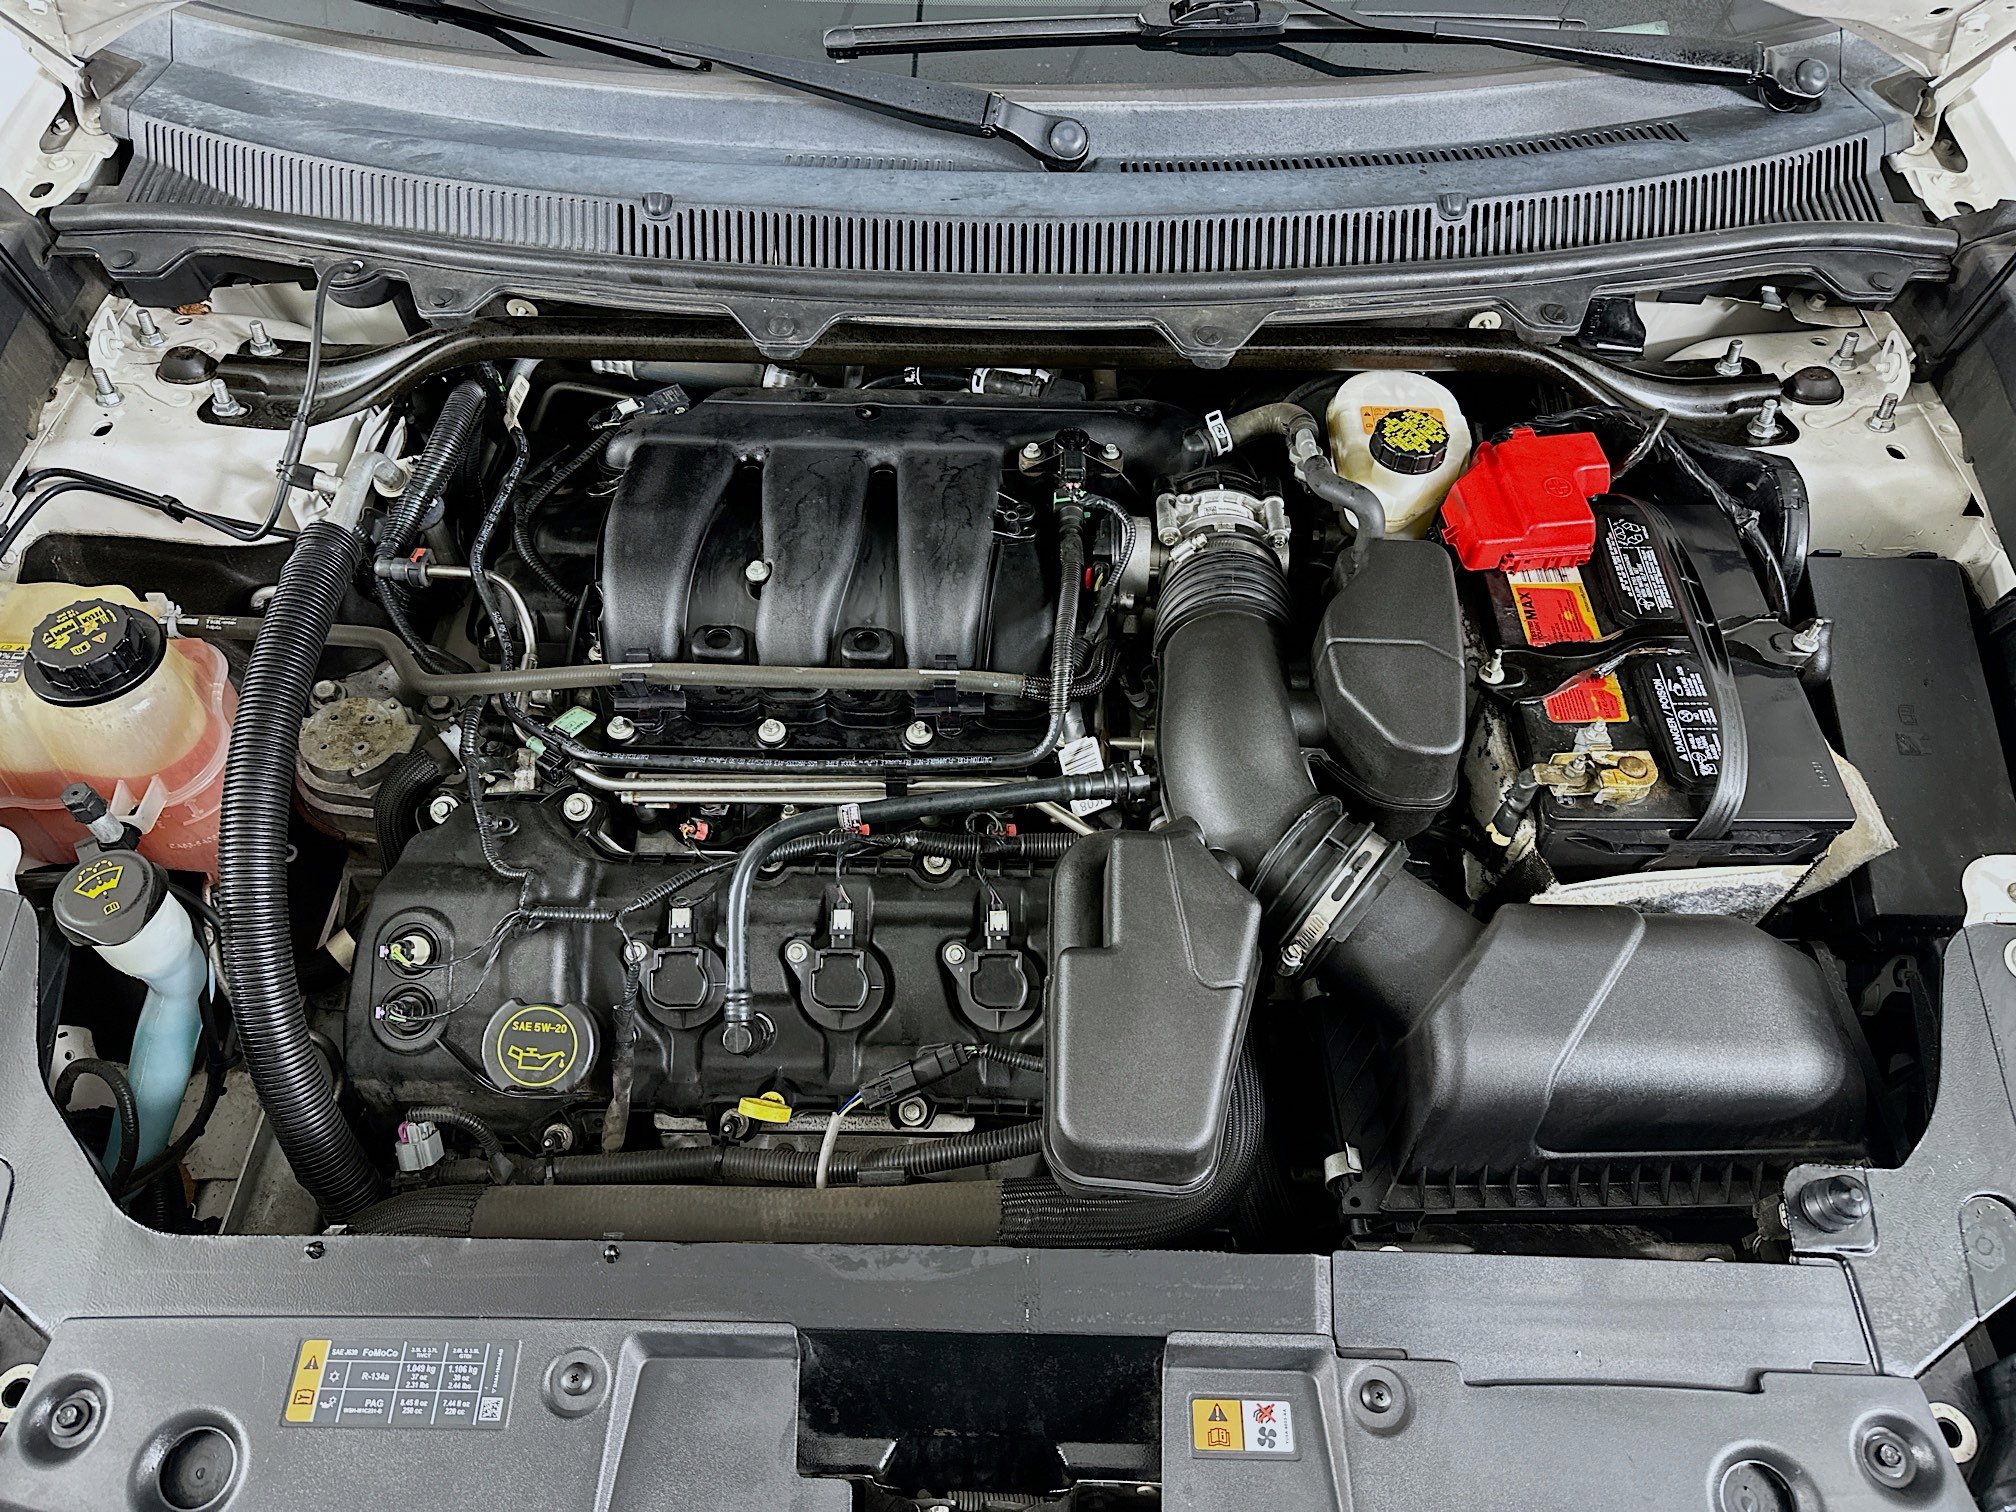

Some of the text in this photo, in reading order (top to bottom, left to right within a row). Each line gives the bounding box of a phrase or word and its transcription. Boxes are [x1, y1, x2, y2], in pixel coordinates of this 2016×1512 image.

[1518, 592, 1538, 620] MAX
[1652, 678, 1672, 710] POISON
[1665, 717, 1686, 753] DANGER
[512, 1021, 568, 1034] SAE 5W-20
[332, 1348, 344, 1356] SAE
[362, 1348, 399, 1357] FoMoCo
[406, 1364, 437, 1375] 1.049 kg
[448, 1365, 479, 1376] 1.106 kg
[361, 1371, 390, 1381] R-134a
[411, 1373, 420, 1381] 37
[419, 1381, 430, 1389] lbs
[447, 1382, 472, 1390] 2.44 lbs
[364, 1399, 385, 1408] PAG
[442, 1400, 457, 1408] 7.44
[444, 1407, 457, 1416] 220
